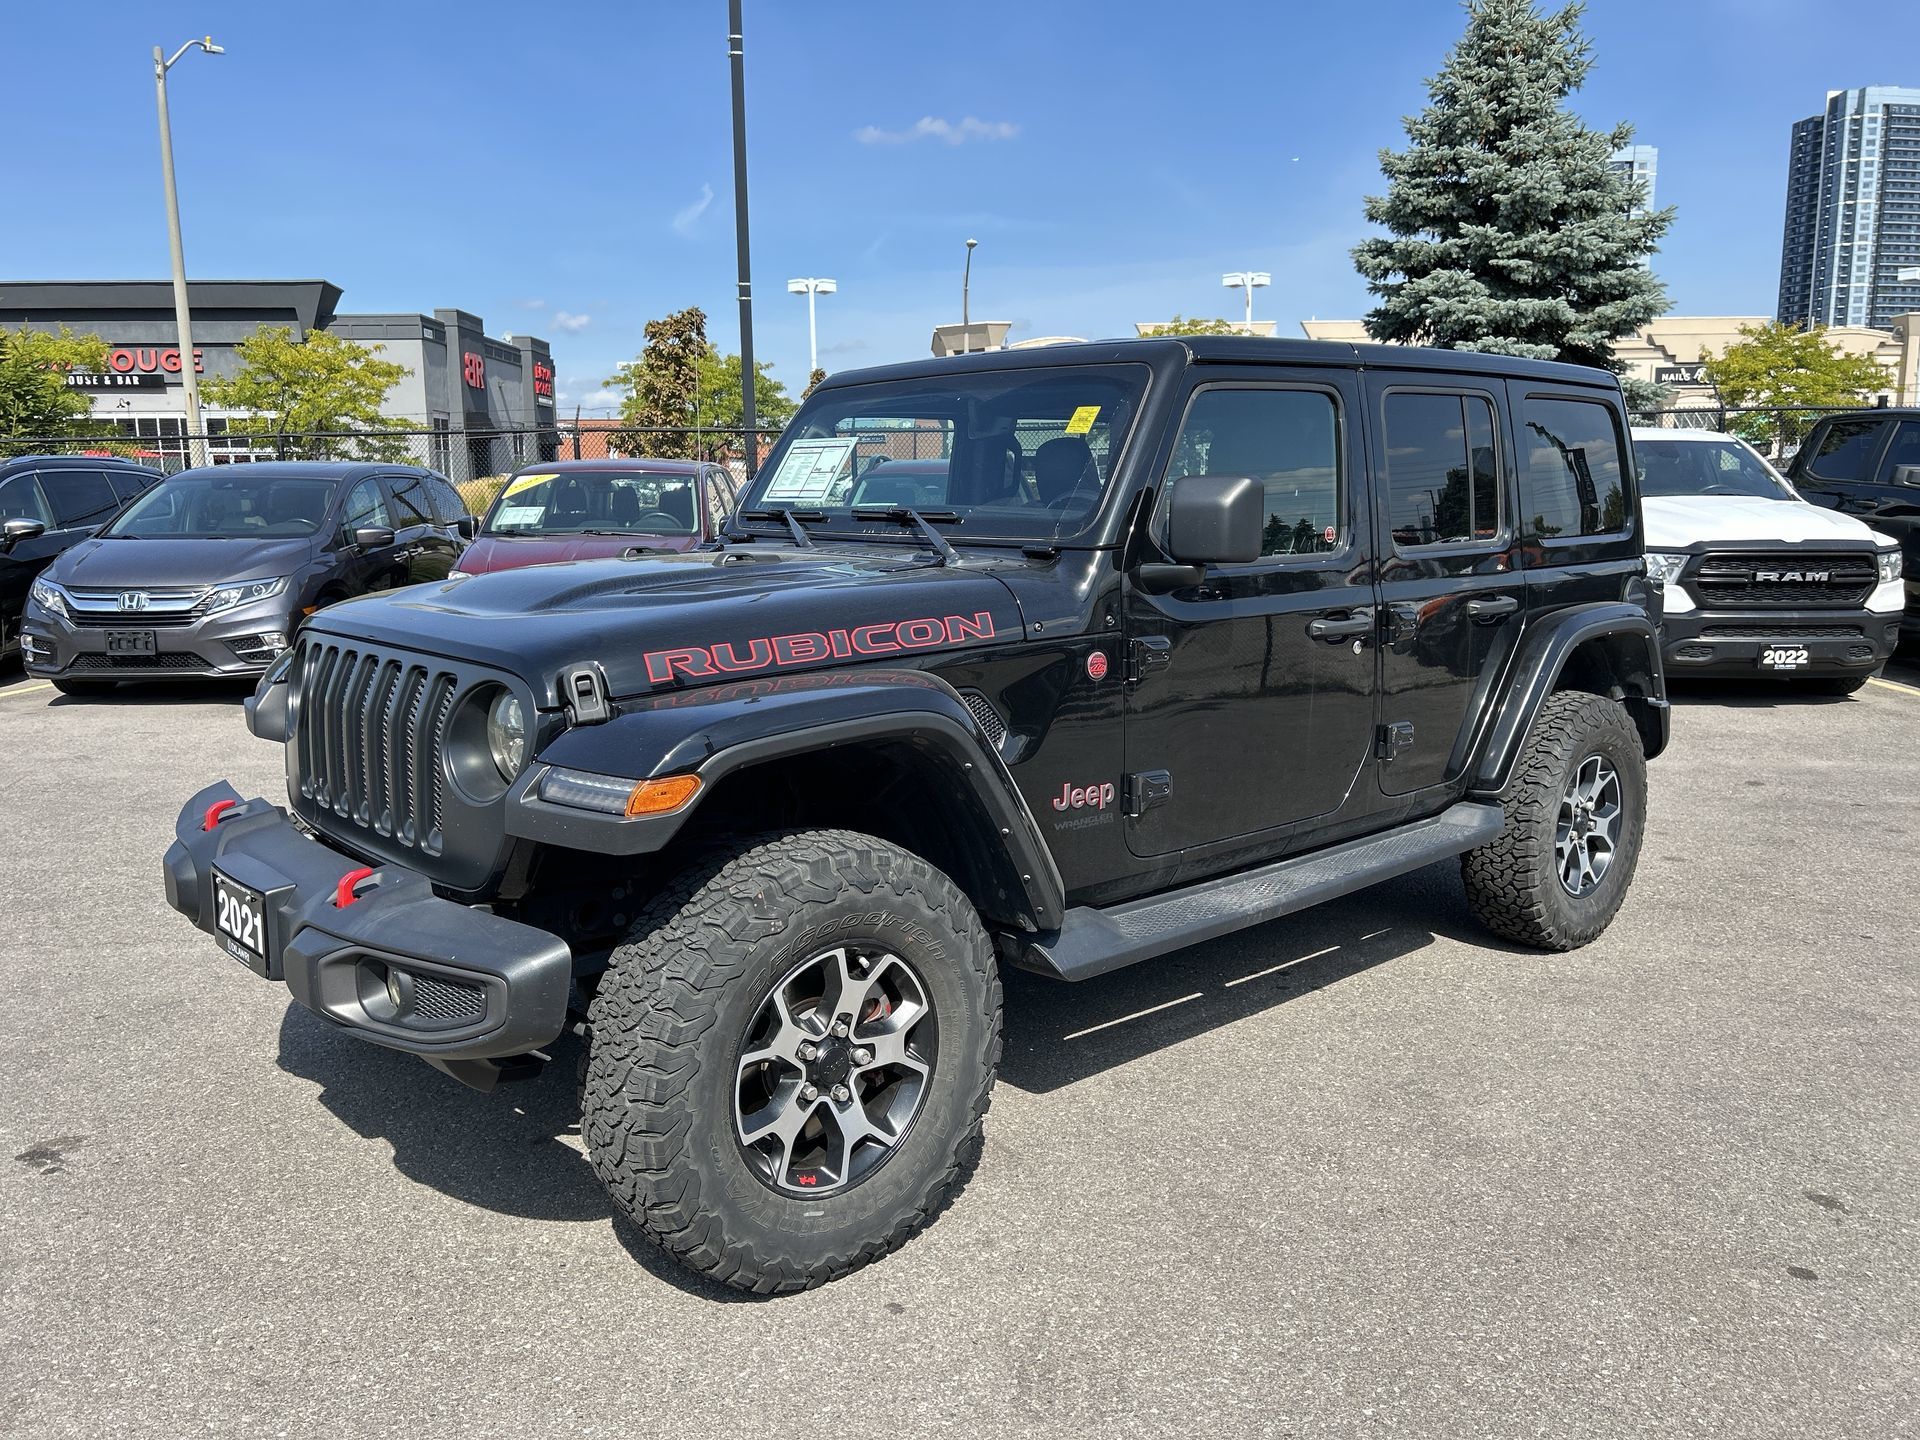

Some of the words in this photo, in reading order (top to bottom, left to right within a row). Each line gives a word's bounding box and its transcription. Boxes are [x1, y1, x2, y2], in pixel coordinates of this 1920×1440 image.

[102, 348, 204, 372] OUGE
[65, 375, 98, 385] OUSE
[104, 375, 111, 385] &
[117, 375, 140, 385] BAR
[1755, 571, 1829, 582] RAM
[643, 611, 995, 683] RUBICON
[1763, 649, 1808, 664] 2022
[1053, 782, 1115, 812] Jeep
[1054, 812, 1113, 831] WRANGLER
[218, 889, 264, 956] 2021
[746, 909, 947, 1003] BFGoodrich
